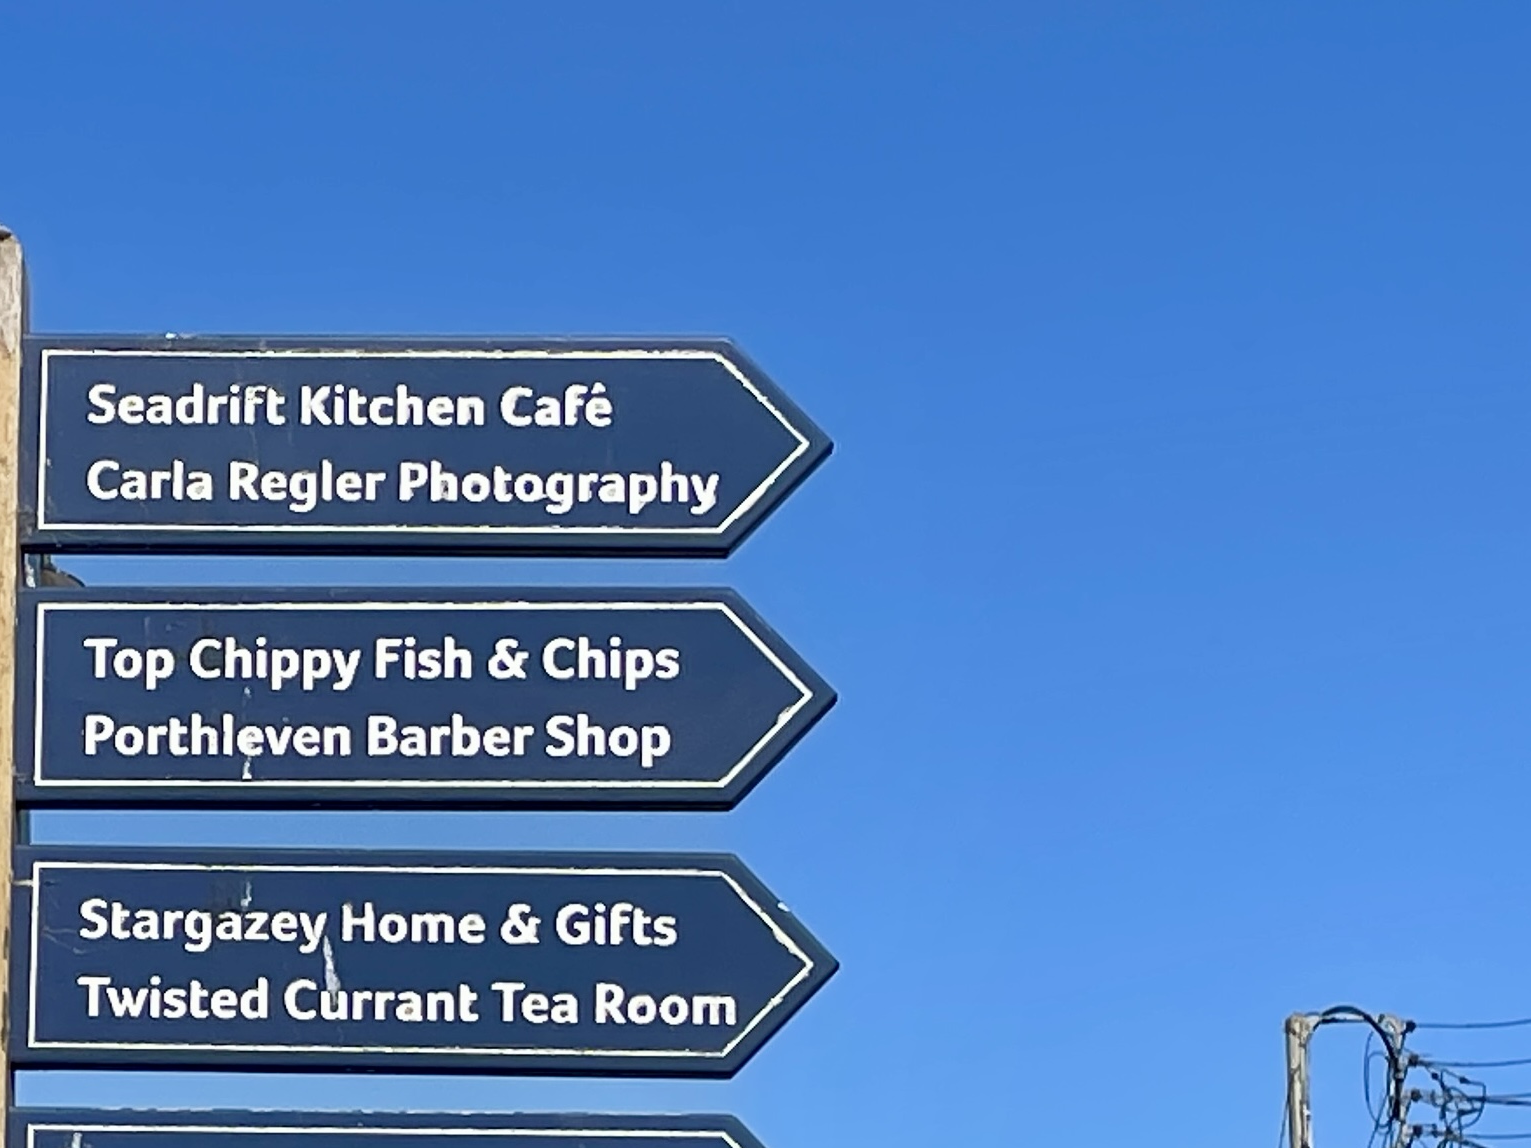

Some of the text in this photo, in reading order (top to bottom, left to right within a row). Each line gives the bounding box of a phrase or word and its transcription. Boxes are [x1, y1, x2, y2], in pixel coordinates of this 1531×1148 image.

[87, 382, 613, 428] Seadrift Kitchen Café
[88, 459, 720, 515] Carla Regler Photography
[83, 637, 680, 694] Top Chippy Fish & Chips
[82, 713, 671, 768] Porthleven Barber Shop
[79, 898, 678, 952] Stargazey Home & Gifts
[77, 976, 738, 1028] Twisted Currant Tea Room
